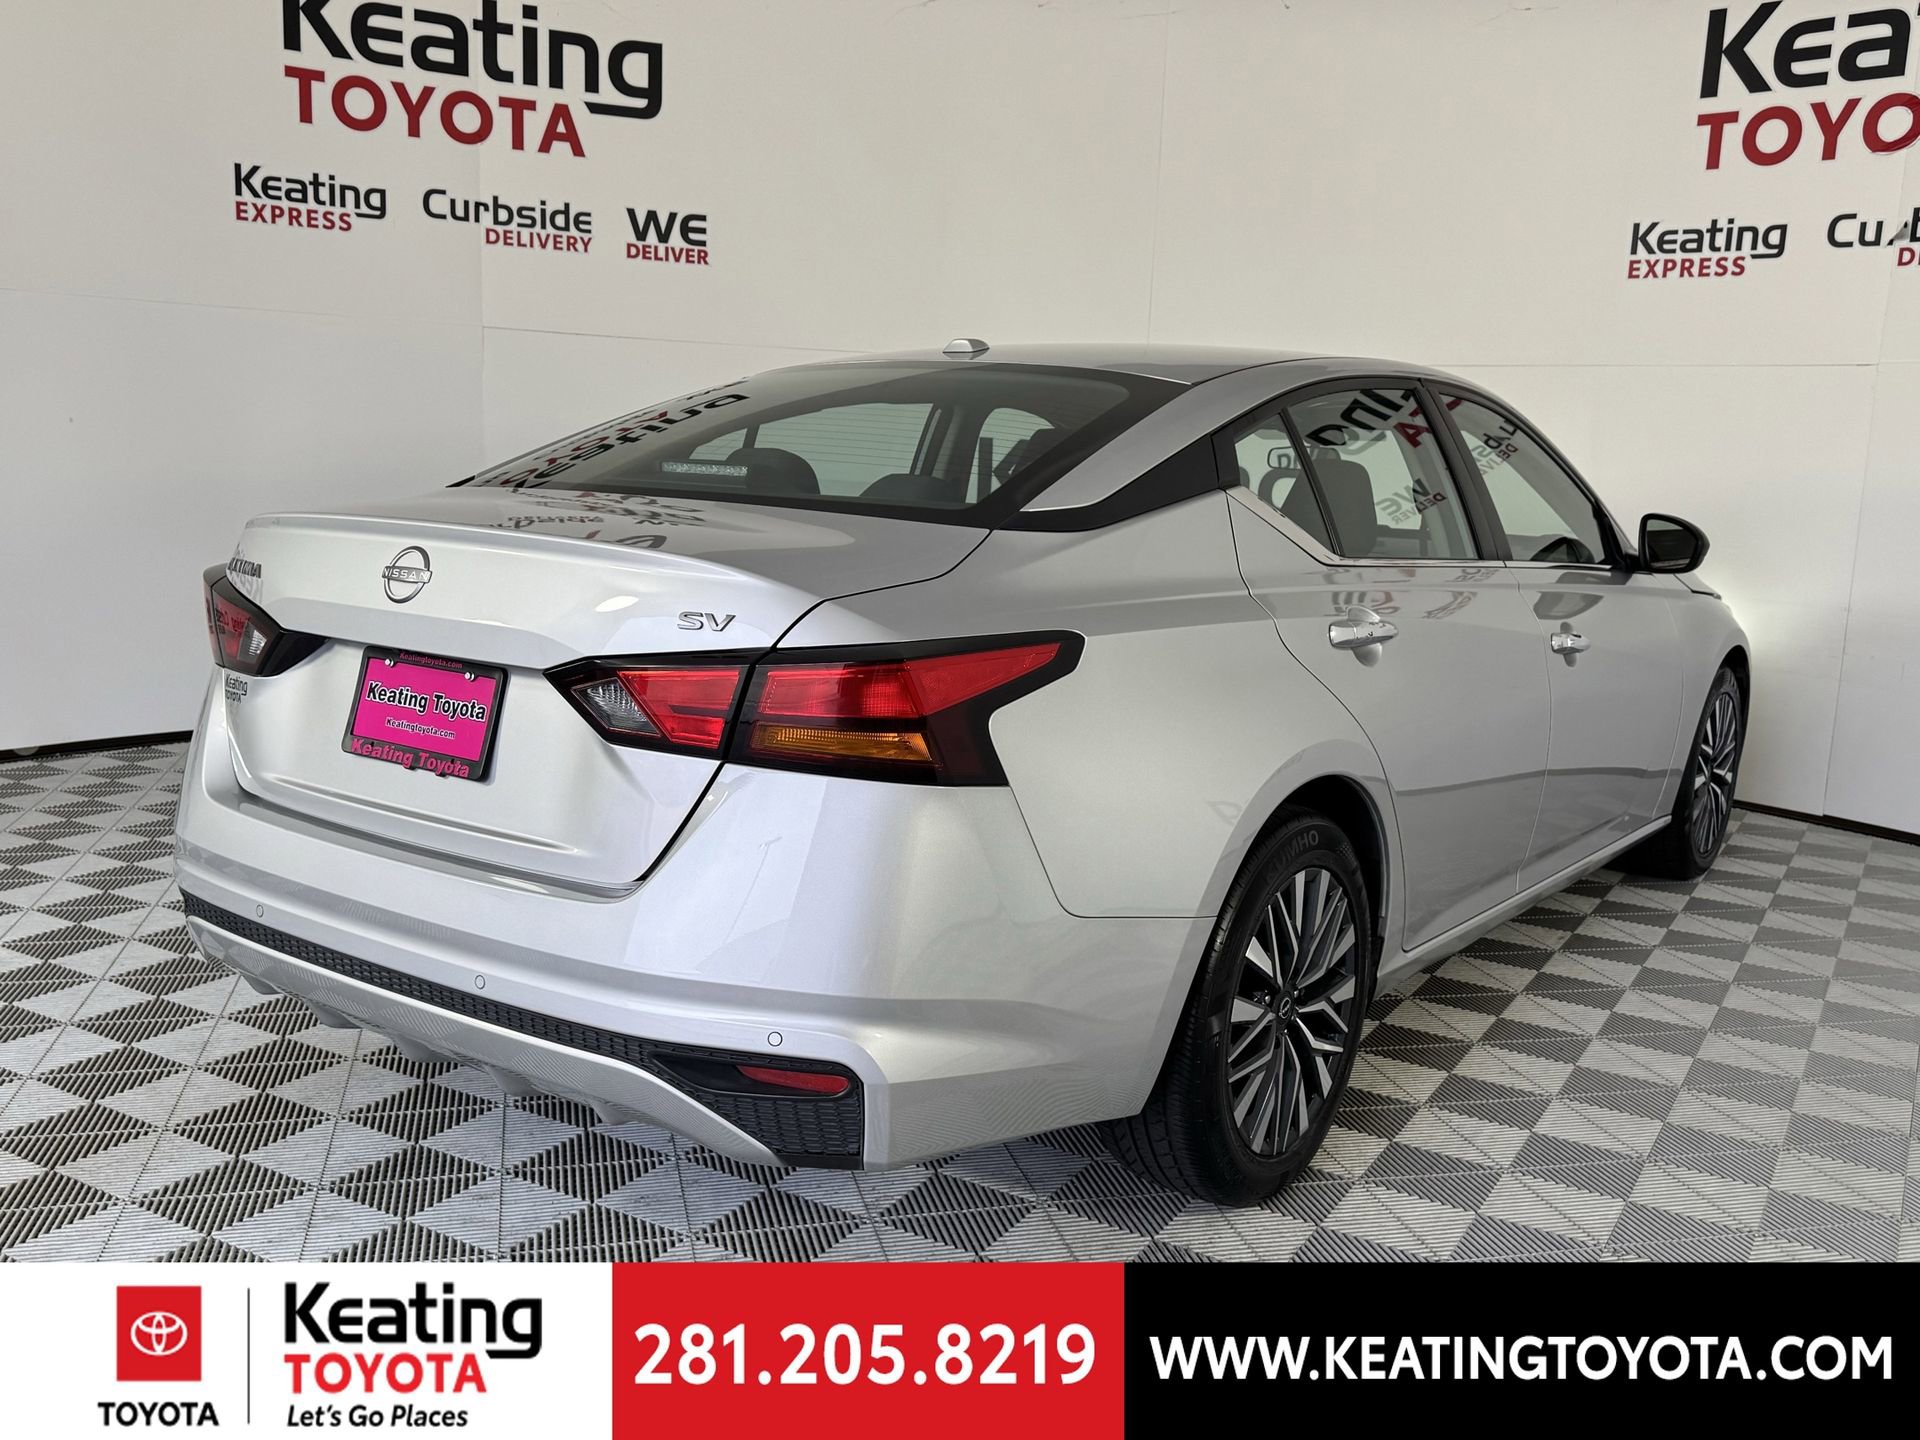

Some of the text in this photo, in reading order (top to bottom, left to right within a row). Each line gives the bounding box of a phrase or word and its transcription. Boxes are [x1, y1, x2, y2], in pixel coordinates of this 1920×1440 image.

[283, 0, 663, 119] Keating
[1700, 0, 1920, 99] Kea
[284, 65, 586, 158] TOYOTA
[234, 163, 386, 220] Keating
[235, 201, 352, 232] EXPRESS
[423, 189, 592, 234] Curbside
[626, 208, 707, 247] WE
[485, 228, 592, 254] DELIVERY
[626, 243, 709, 265] DELIVER
[1630, 218, 1788, 259] Keating
[1627, 256, 1746, 279] EXPRESS
[384, 567, 430, 581] NISSAN
[677, 611, 736, 632] SV
[400, 652, 462, 669] Keatingtoyota.com
[366, 682, 487, 721] Keating Toyota
[386, 717, 455, 739] Keatingtoyota.com
[351, 738, 470, 778] Keating Toyota
